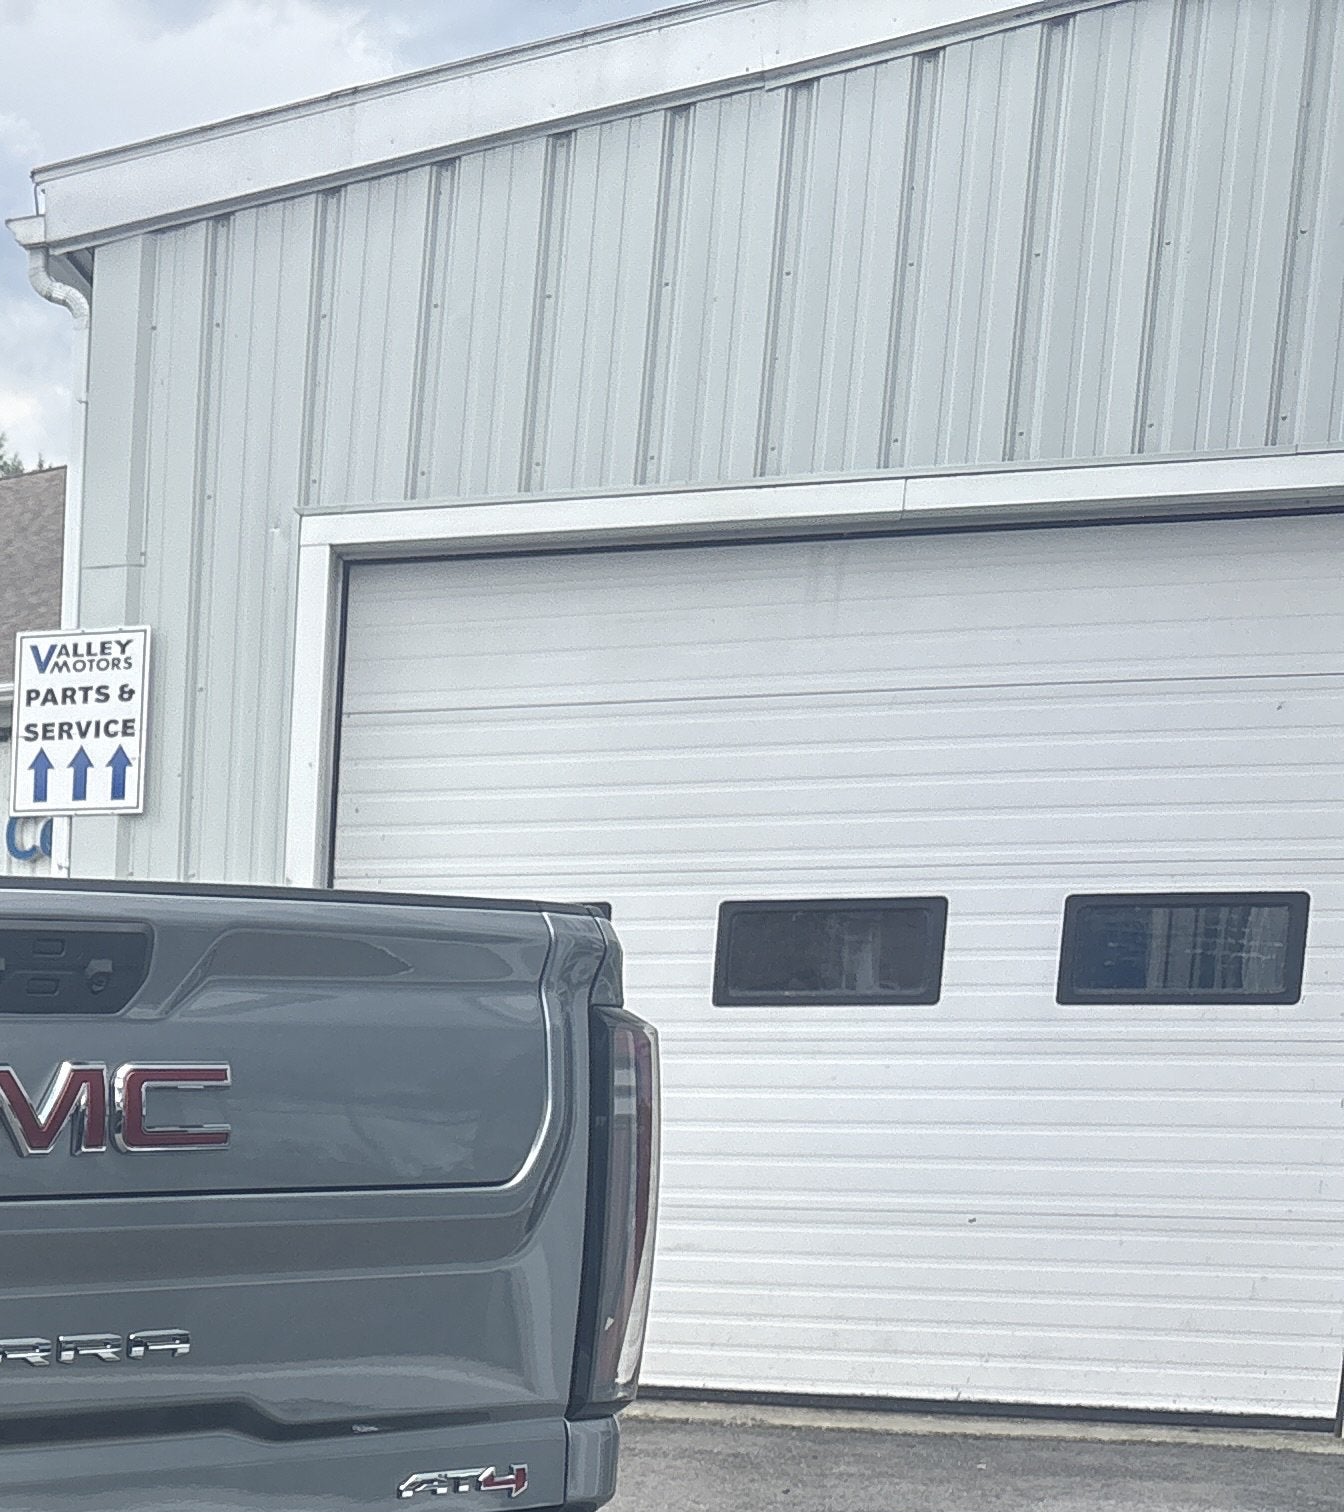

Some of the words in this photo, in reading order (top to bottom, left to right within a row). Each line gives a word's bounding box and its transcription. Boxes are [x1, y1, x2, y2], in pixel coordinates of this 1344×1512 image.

[30, 639, 134, 674] VALLEY
[50, 656, 133, 674] MOTORS
[25, 685, 111, 707] PARTS
[117, 683, 136, 702] &
[23, 718, 137, 742] SERVICE
[397, 1463, 528, 1499] AT4
